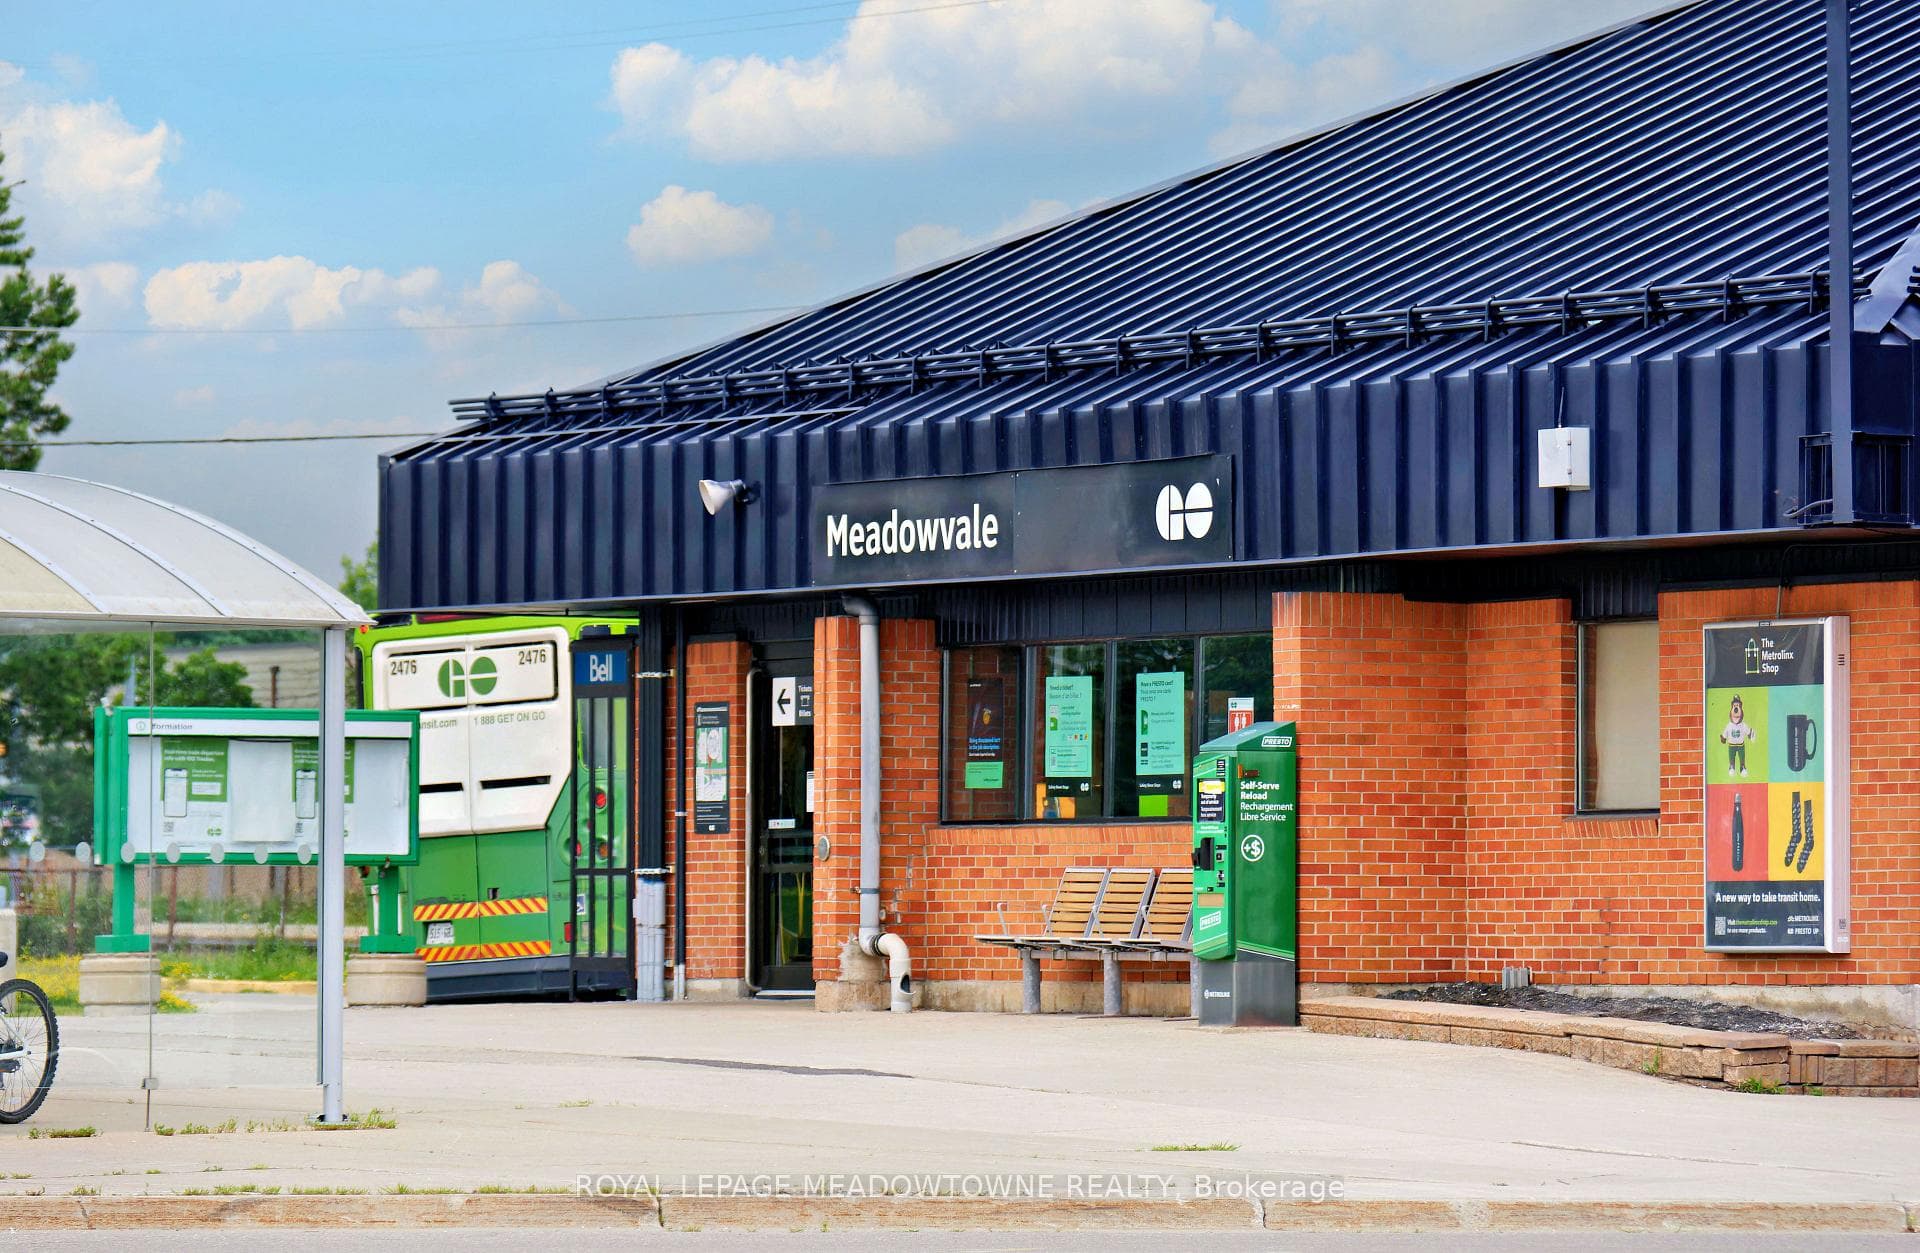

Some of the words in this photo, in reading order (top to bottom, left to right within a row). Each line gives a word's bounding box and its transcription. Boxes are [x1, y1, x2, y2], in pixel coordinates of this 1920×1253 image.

[827, 503, 999, 557] Meadowvale
[1761, 638, 1774, 648] The
[519, 649, 546, 665] 2476
[1761, 650, 1794, 661] Metrolinx
[391, 659, 417, 676] 2476
[589, 654, 613, 682] Bell
[1761, 663, 1779, 675] Shop
[481, 714, 495, 726] 888
[497, 713, 515, 725] GET
[517, 712, 530, 723] ON
[531, 711, 546, 721] GO
[1264, 738, 1290, 746] PRESTO
[1240, 781, 1280, 790] Self-Serve
[1240, 791, 1268, 800] Reload
[1240, 801, 1294, 813] Rechargement
[1240, 812, 1260, 821] Libre
[1260, 812, 1287, 821] Service
[1716, 892, 1722, 903] A
[1722, 895, 1736, 903] new
[1738, 895, 1752, 905] way
[1753, 893, 1761, 903] to
[1762, 892, 1777, 903] take
[1778, 892, 1798, 903] transit
[1799, 892, 1821, 902] home.
